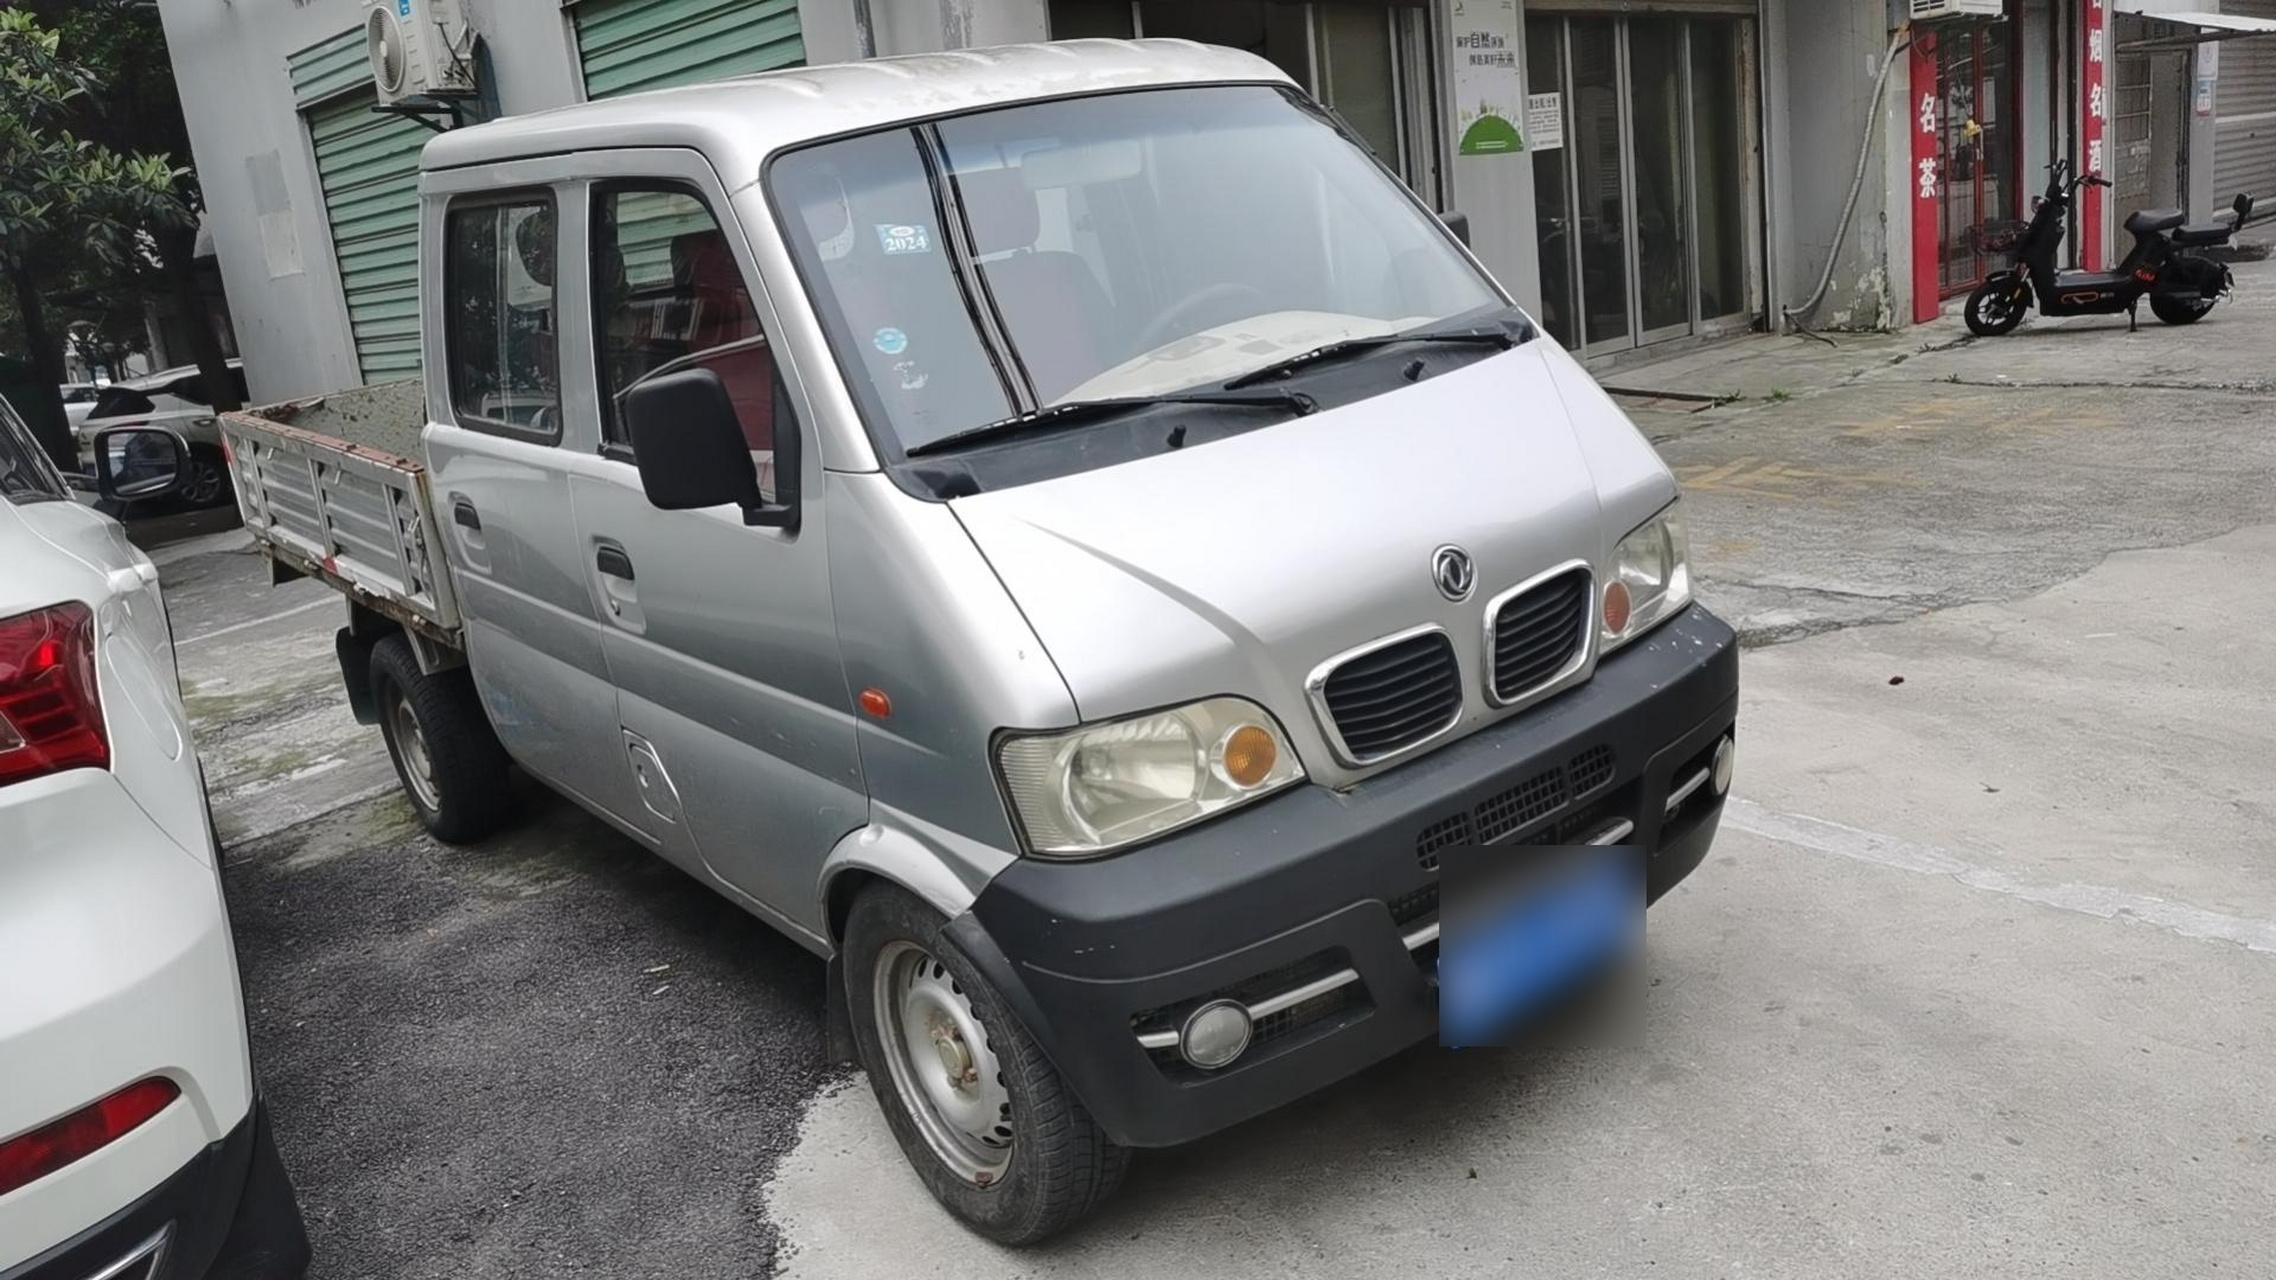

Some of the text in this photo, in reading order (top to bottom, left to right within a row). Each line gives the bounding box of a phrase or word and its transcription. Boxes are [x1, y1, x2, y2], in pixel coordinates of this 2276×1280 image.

[2089, 0, 2102, 172] 烟名酒
[1919, 92, 1936, 198] 名茶
[884, 236, 927, 251] 2024
